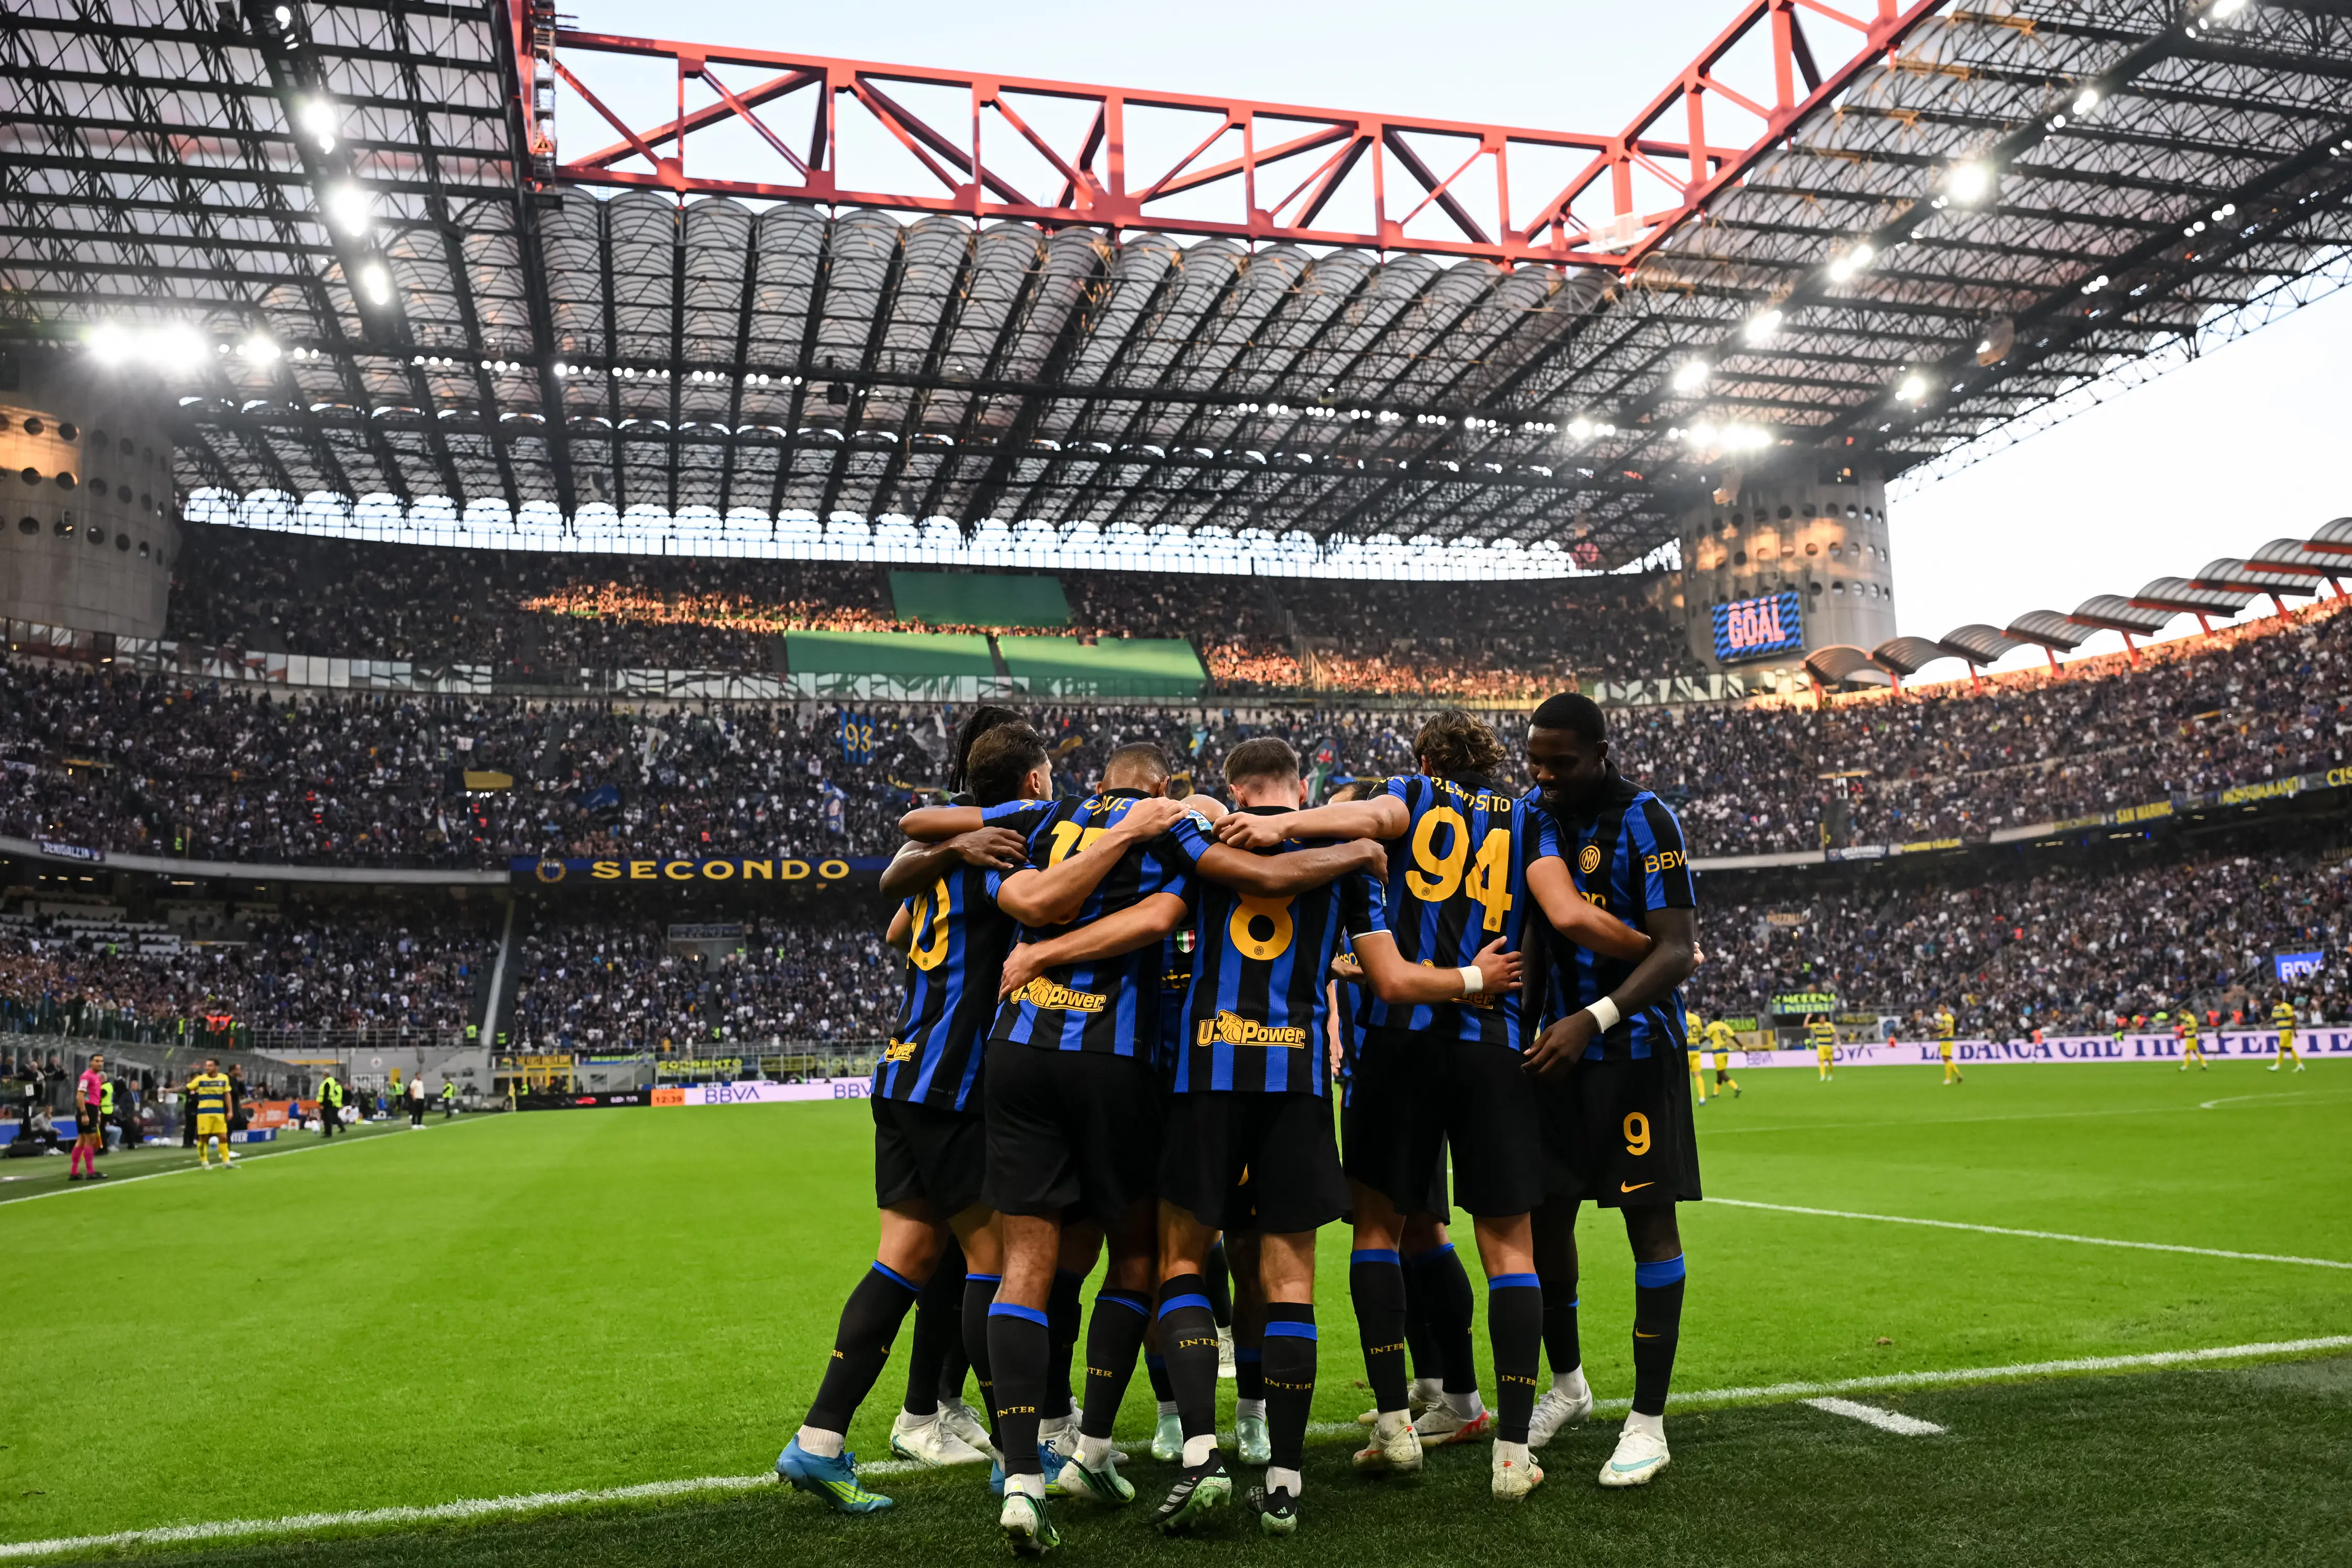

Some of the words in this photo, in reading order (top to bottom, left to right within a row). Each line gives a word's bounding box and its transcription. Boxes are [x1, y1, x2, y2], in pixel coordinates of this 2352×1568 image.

[1728, 596, 1785, 649] GOAL
[845, 723, 873, 753] 93
[591, 860, 849, 880] SECONDO
[1405, 805, 1513, 932] 94
[1643, 850, 1688, 873] BBV
[1241, 1020, 1304, 1044] Power
[706, 1086, 760, 1104] BBVA
[834, 1083, 871, 1099] BBV
[230, 1132, 248, 1142] NTER
[1623, 1112, 1651, 1156] 9
[1370, 1343, 1404, 1354] INTER
[1086, 1367, 1113, 1378] TER
[1501, 1375, 1536, 1387] INTER
[1264, 1377, 1312, 1390] INTER
